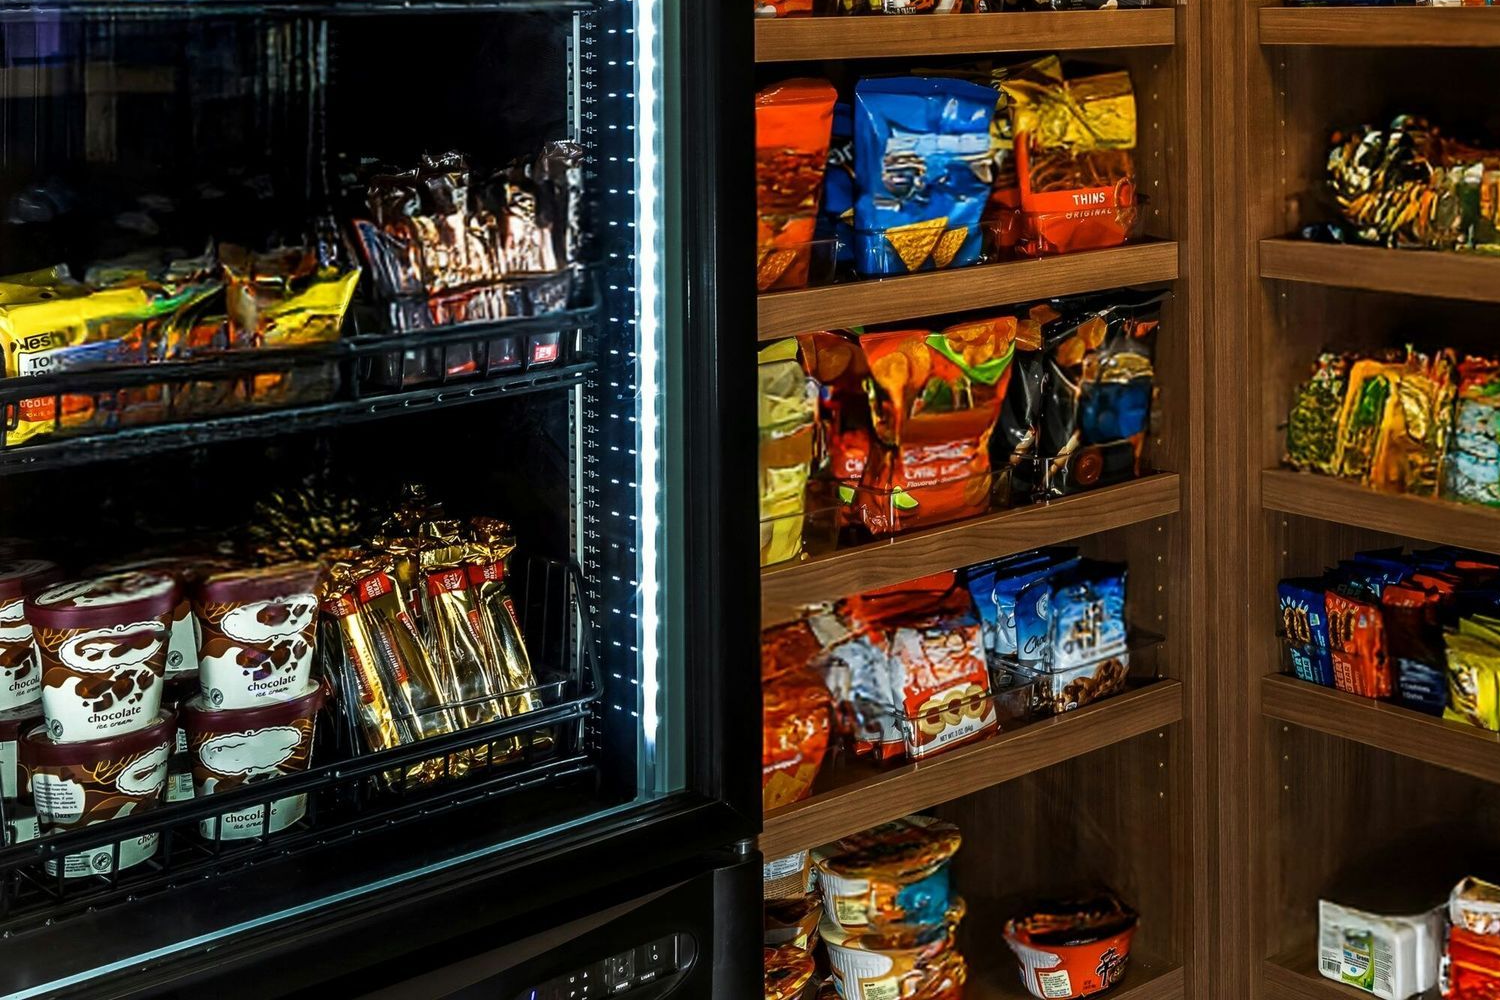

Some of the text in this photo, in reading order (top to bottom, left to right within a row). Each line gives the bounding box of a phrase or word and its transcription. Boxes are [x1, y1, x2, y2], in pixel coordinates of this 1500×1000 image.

[1072, 192, 1106, 206] THINS
[1065, 209, 1111, 220] ORIGINAL
[20, 398, 54, 408] OCOLA
[907, 480, 938, 488] Flavored
[247, 674, 297, 692] chocolate
[268, 686, 289, 696] cream
[88, 706, 141, 724] chocolate
[110, 718, 133, 728] cream
[940, 734, 949, 742] NET
[225, 807, 277, 823] chocolae
